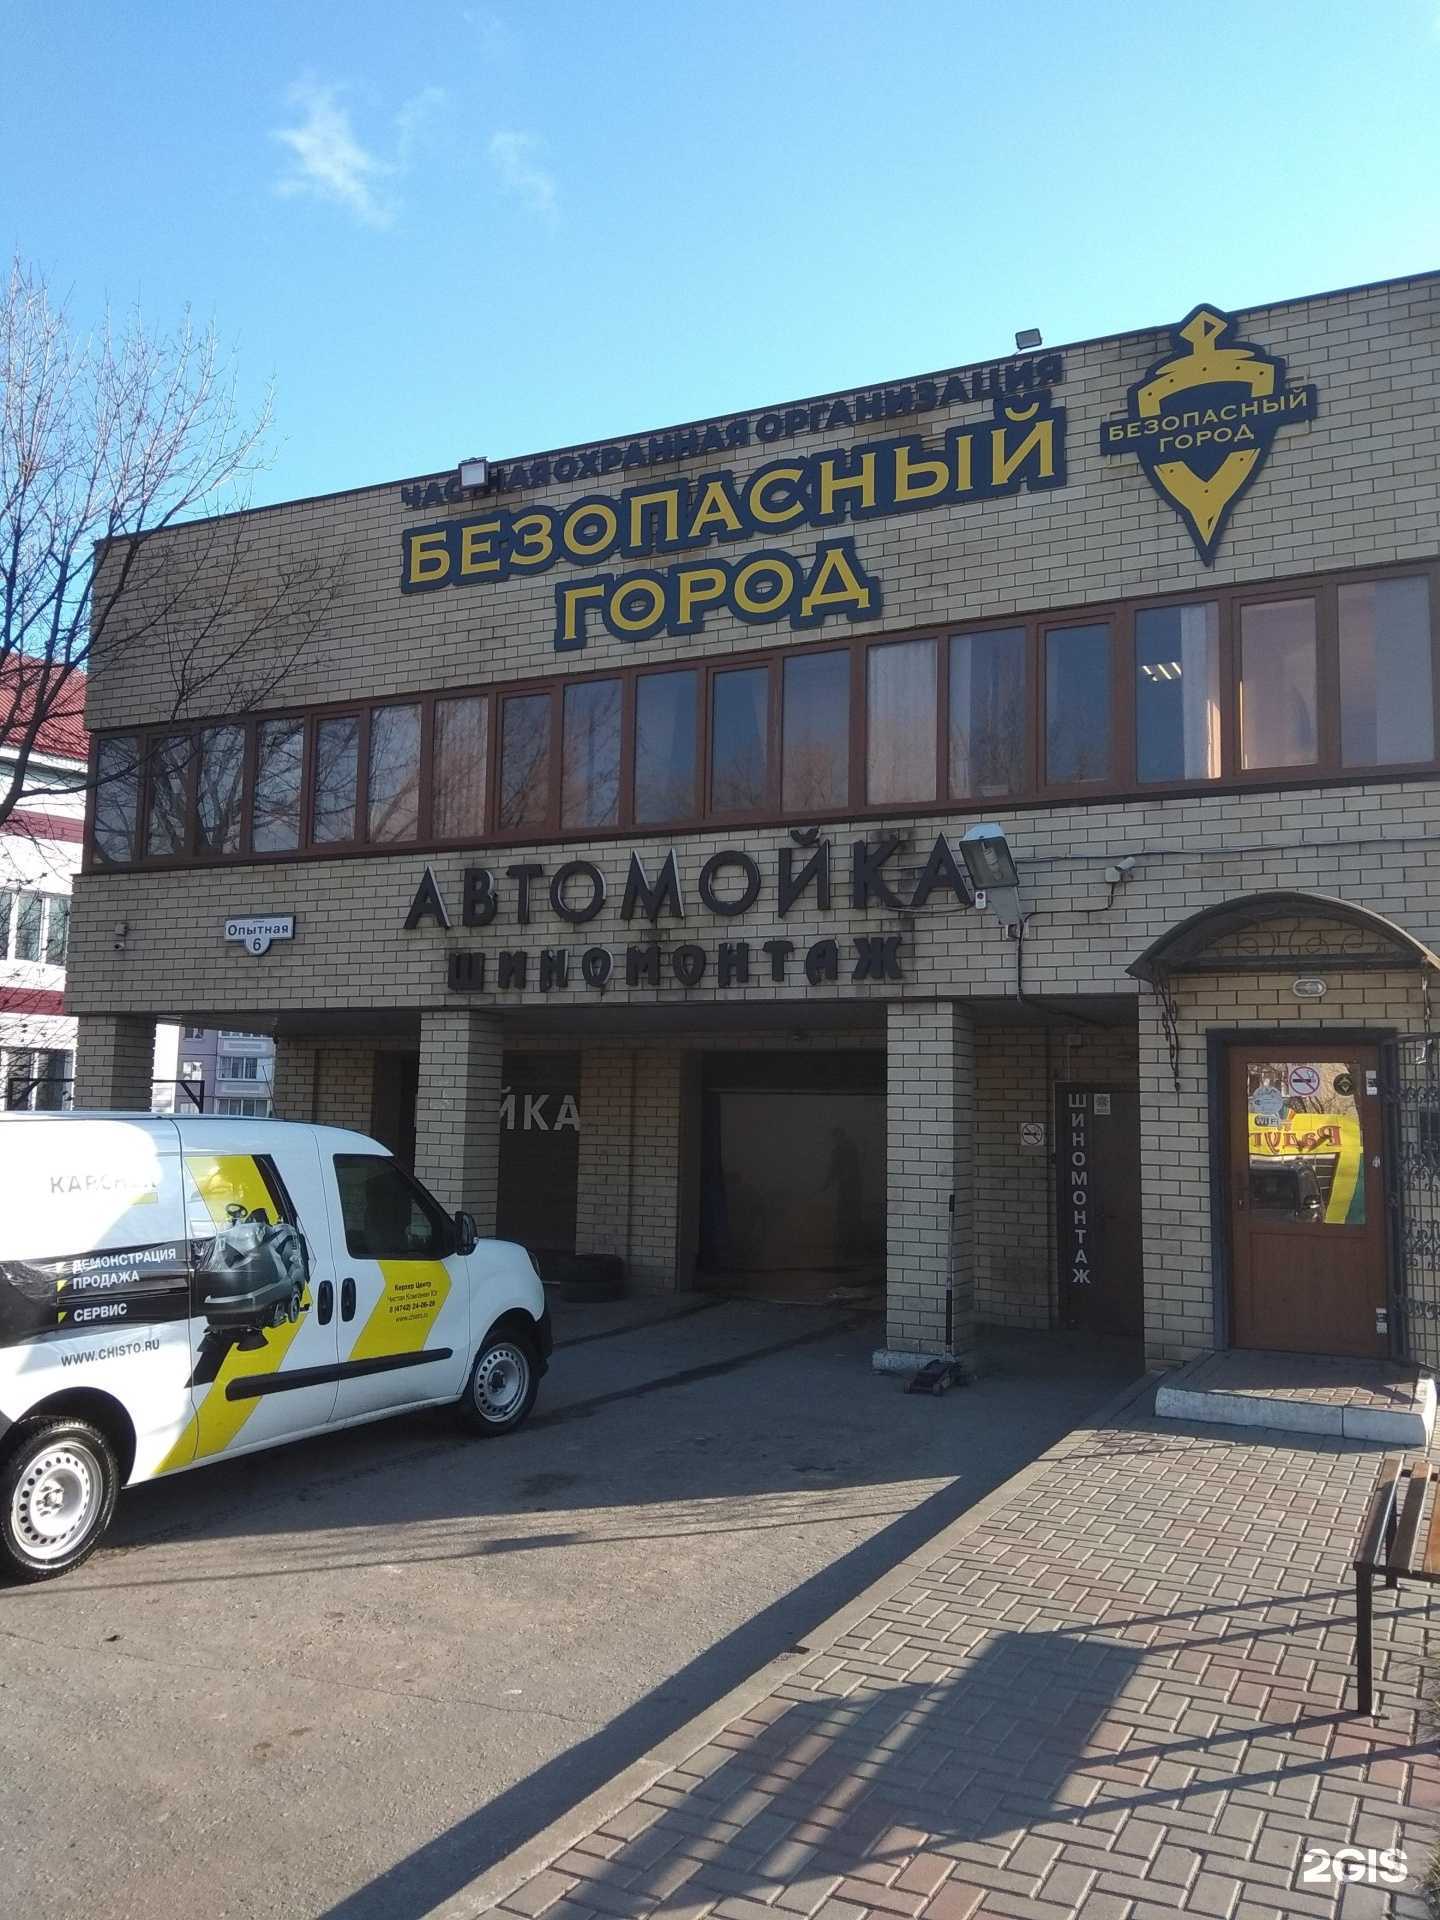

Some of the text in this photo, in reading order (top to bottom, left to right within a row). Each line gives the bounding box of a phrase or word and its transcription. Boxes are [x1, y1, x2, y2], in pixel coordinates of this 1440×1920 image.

[401, 354, 1064, 508] ЧАСНАЯ ОХРАННАЯ ОРГАНИЗАЦИЯ
[1109, 389, 1308, 441] БЕЗОПАСНЫЙ
[1159, 424, 1255, 453] ГОРОД
[406, 400, 1057, 585] БЕЗОПАСНЫЙ
[561, 547, 871, 640] ГОРОД
[403, 826, 975, 929] АВТОМОЙКА
[228, 924, 290, 936] Опытная
[253, 938, 262, 952] 6
[448, 937, 904, 993] ШИНОМОНТАЖ
[1068, 1094, 1091, 1284] ШИНОМОНТАЖ
[72, 1248, 177, 1274] ДЕМОНСТРАЦИЯ
[73, 1270, 140, 1290] ПРОДАЖА
[74, 1302, 128, 1322] СЕРВИС
[61, 1339, 160, 1367] WWW.CHISTO.RU
